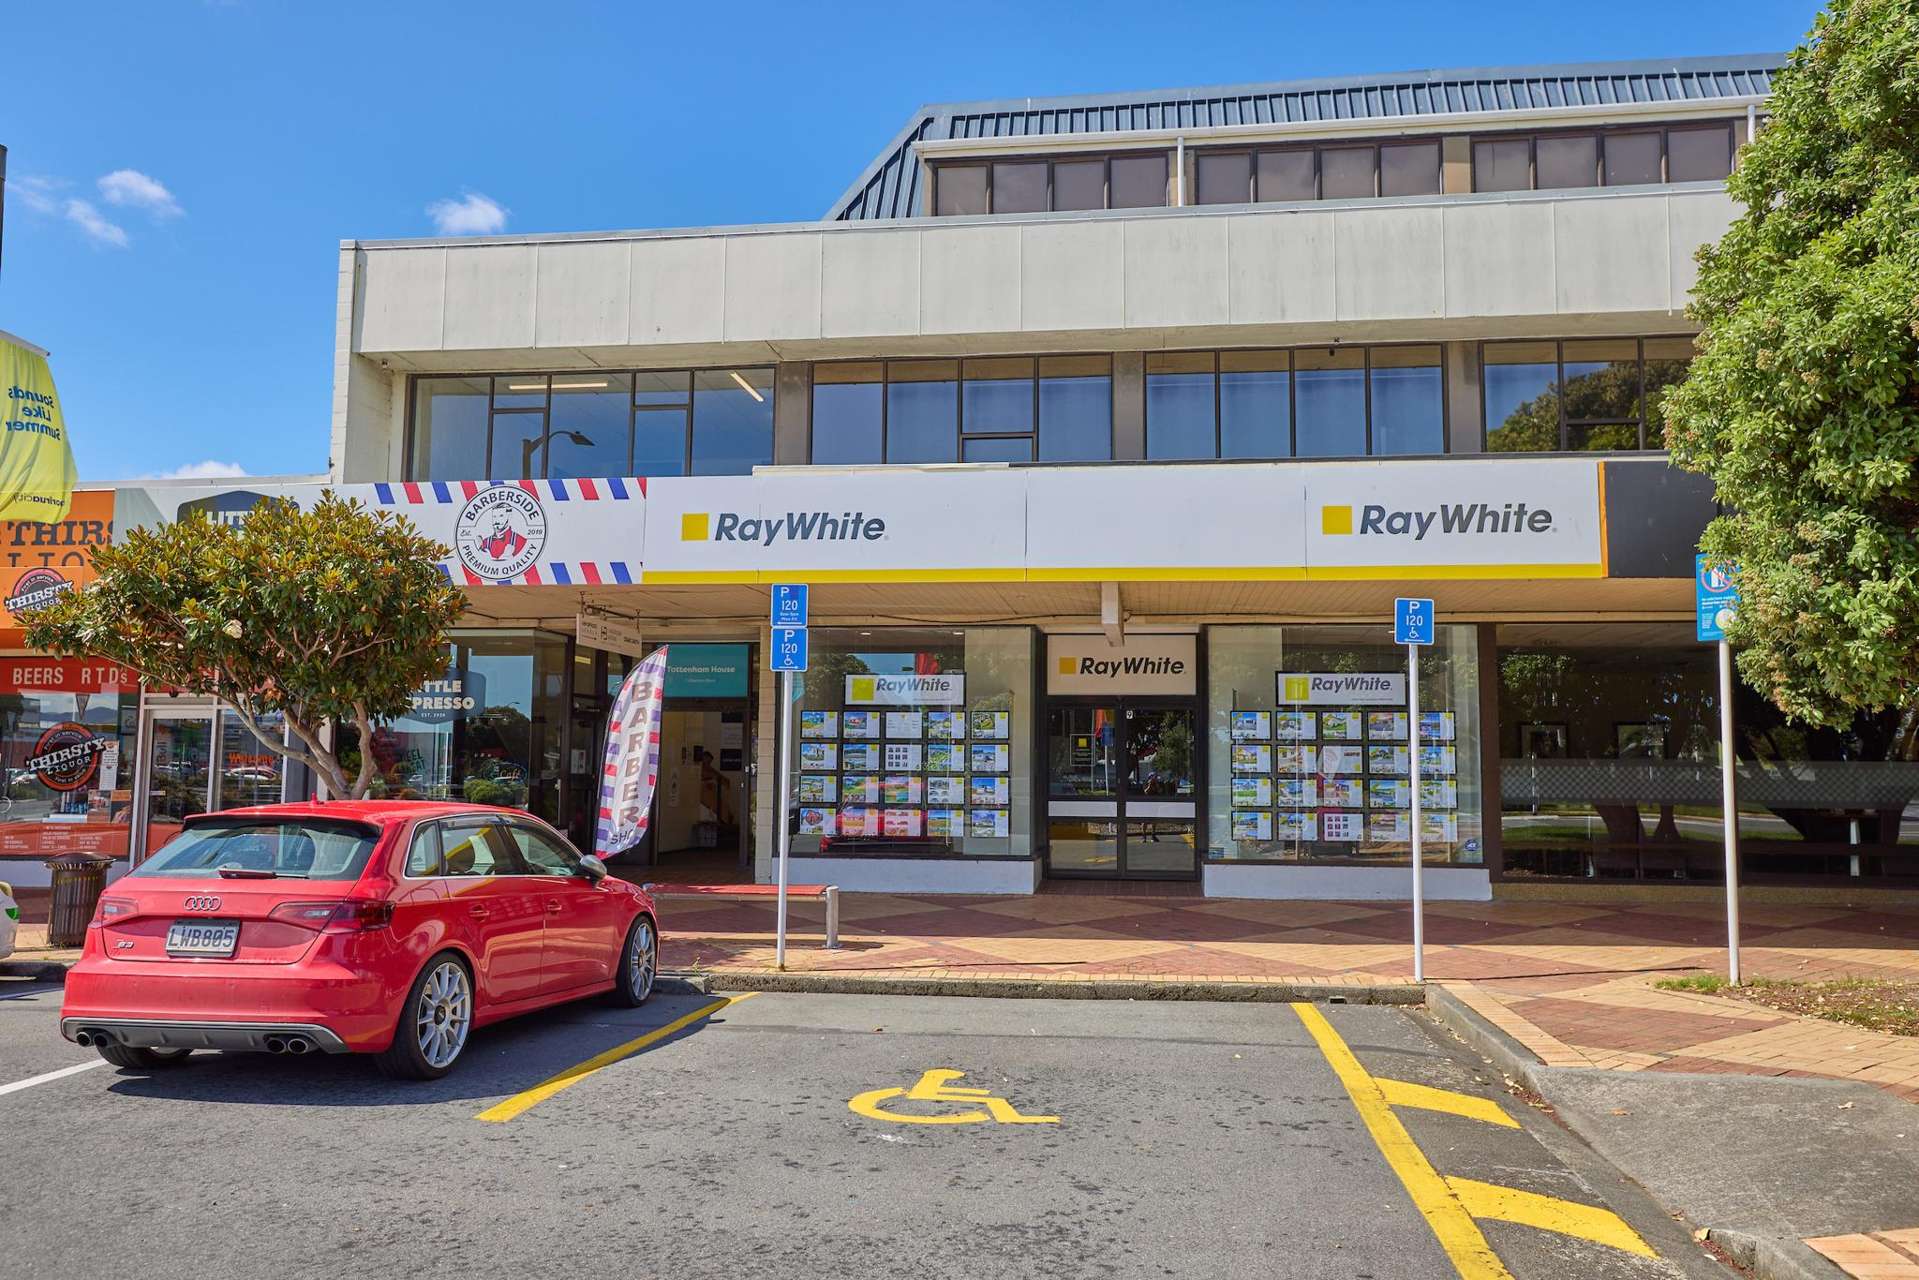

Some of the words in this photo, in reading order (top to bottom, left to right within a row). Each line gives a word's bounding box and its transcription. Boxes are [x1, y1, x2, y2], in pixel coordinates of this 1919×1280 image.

[465, 491, 540, 521] BARBERSIDE
[206, 511, 255, 526] LITT
[463, 544, 499, 576] PREMIUM
[502, 543, 537, 575] QUALITY
[781, 587, 790, 598] P
[782, 600, 798, 611] 120
[1409, 601, 1420, 614] P
[1405, 615, 1423, 626] 120
[784, 630, 795, 642] P
[781, 643, 798, 654] 120
[667, 665, 710, 673] Tottenham
[711, 665, 736, 673] House
[13, 667, 64, 685] BEERS
[424, 680, 462, 693] TTLE
[412, 696, 475, 710] PRESSO
[27, 737, 105, 771] THIRSTY
[618, 681, 653, 828] BARBER
[167, 928, 234, 947] LWB805
